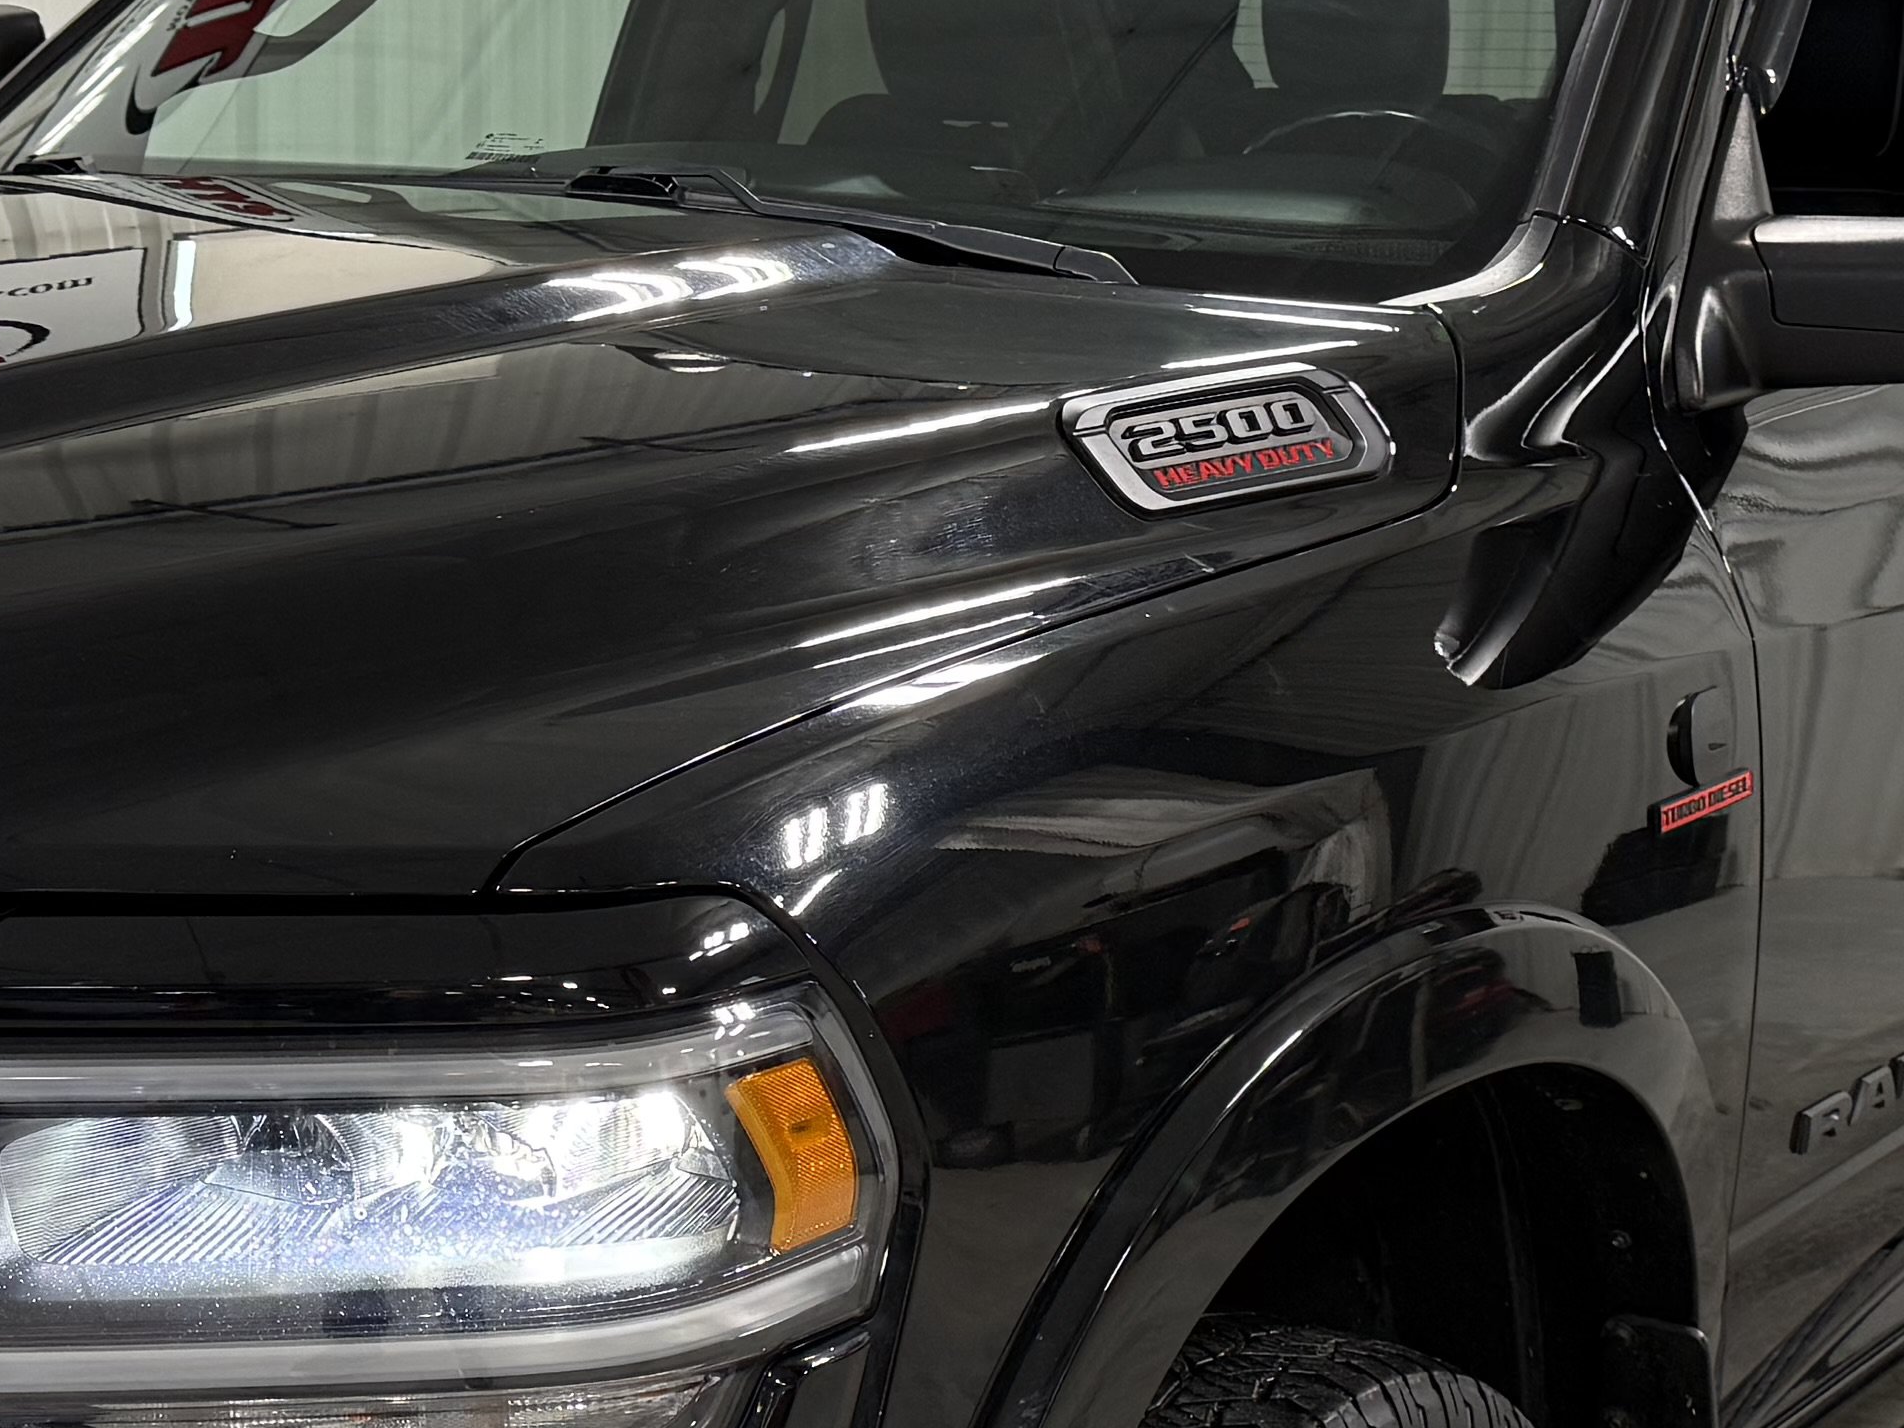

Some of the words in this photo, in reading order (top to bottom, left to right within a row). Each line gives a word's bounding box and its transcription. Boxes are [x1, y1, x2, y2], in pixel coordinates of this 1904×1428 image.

[1126, 399, 1317, 462] 2500
[1153, 453, 1254, 489] HEAVY
[1256, 437, 1335, 469] DUTY
